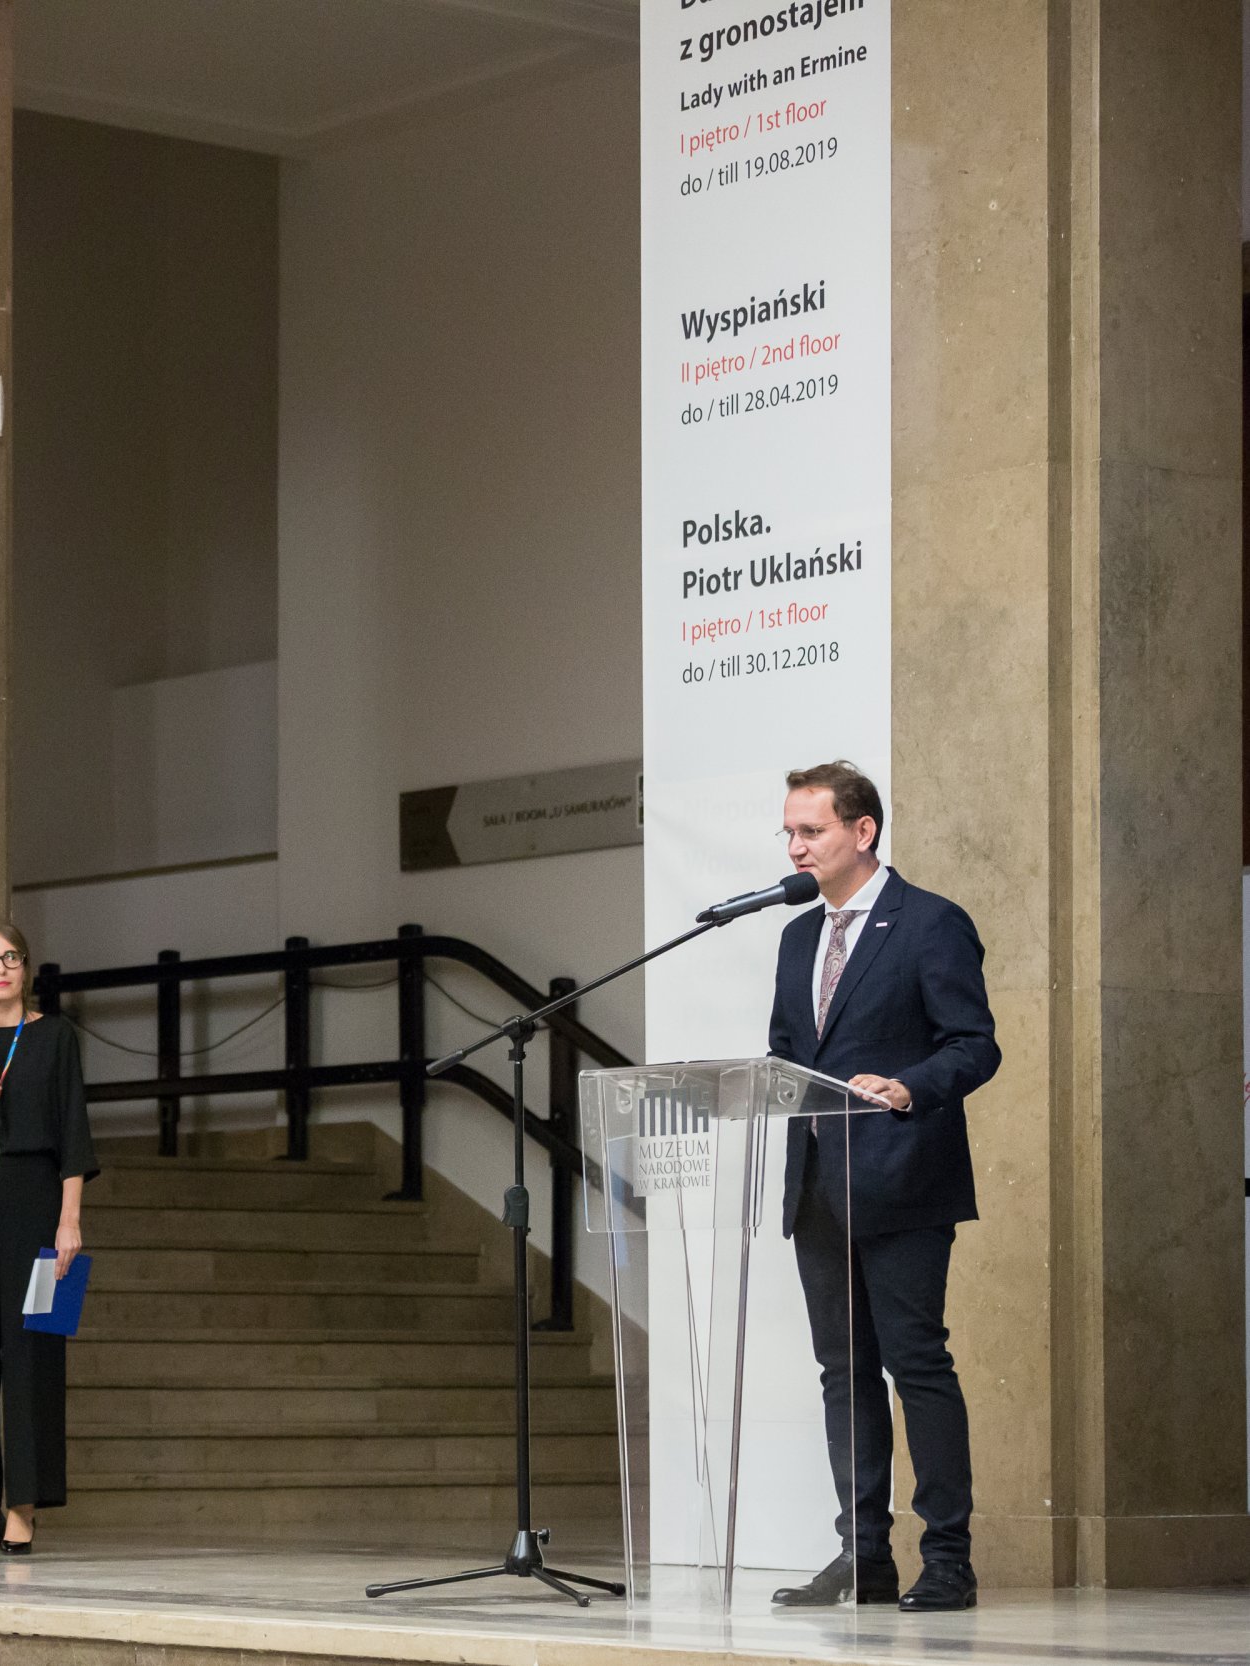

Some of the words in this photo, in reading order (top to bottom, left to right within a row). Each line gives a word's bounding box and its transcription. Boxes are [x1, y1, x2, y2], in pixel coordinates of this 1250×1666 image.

[680, 38, 693, 61] z
[680, 83, 723, 112] Lady
[728, 69, 768, 98] with
[773, 66, 795, 86] an
[800, 45, 868, 78] Ermine
[680, 133, 685, 154] I
[689, 124, 740, 157] piętro
[743, 115, 752, 139] /
[757, 110, 782, 133] 1st
[786, 99, 828, 126] floor
[680, 174, 703, 196] do
[706, 168, 715, 191] /
[718, 160, 739, 187] till
[745, 136, 839, 179] 19.08.2019
[681, 280, 826, 343] Wyspiański
[681, 362, 691, 384] II
[695, 355, 746, 386] piętro
[749, 346, 757, 370] /
[761, 337, 795, 366] 2nd
[799, 333, 841, 358] floor
[681, 402, 703, 425] do
[707, 398, 715, 422] /
[718, 393, 739, 418] till
[744, 373, 839, 413] 28.04.2019
[682, 509, 771, 548] Polska.
[682, 566, 743, 600] Piotr
[750, 540, 862, 588] Uklański
[682, 621, 686, 642] I
[691, 617, 741, 646] piętro
[745, 610, 753, 633] /
[758, 608, 783, 630] 1st
[787, 602, 829, 625] floor
[682, 661, 704, 684] do
[708, 658, 716, 682] /
[719, 654, 740, 678] till
[745, 641, 840, 675] 30.12.2018
[638, 1139, 710, 1160] MUZEUM
[638, 1158, 710, 1176] NARODOWE
[639, 1178, 649, 1191] W
[653, 1175, 711, 1190] KRAKOWIE
